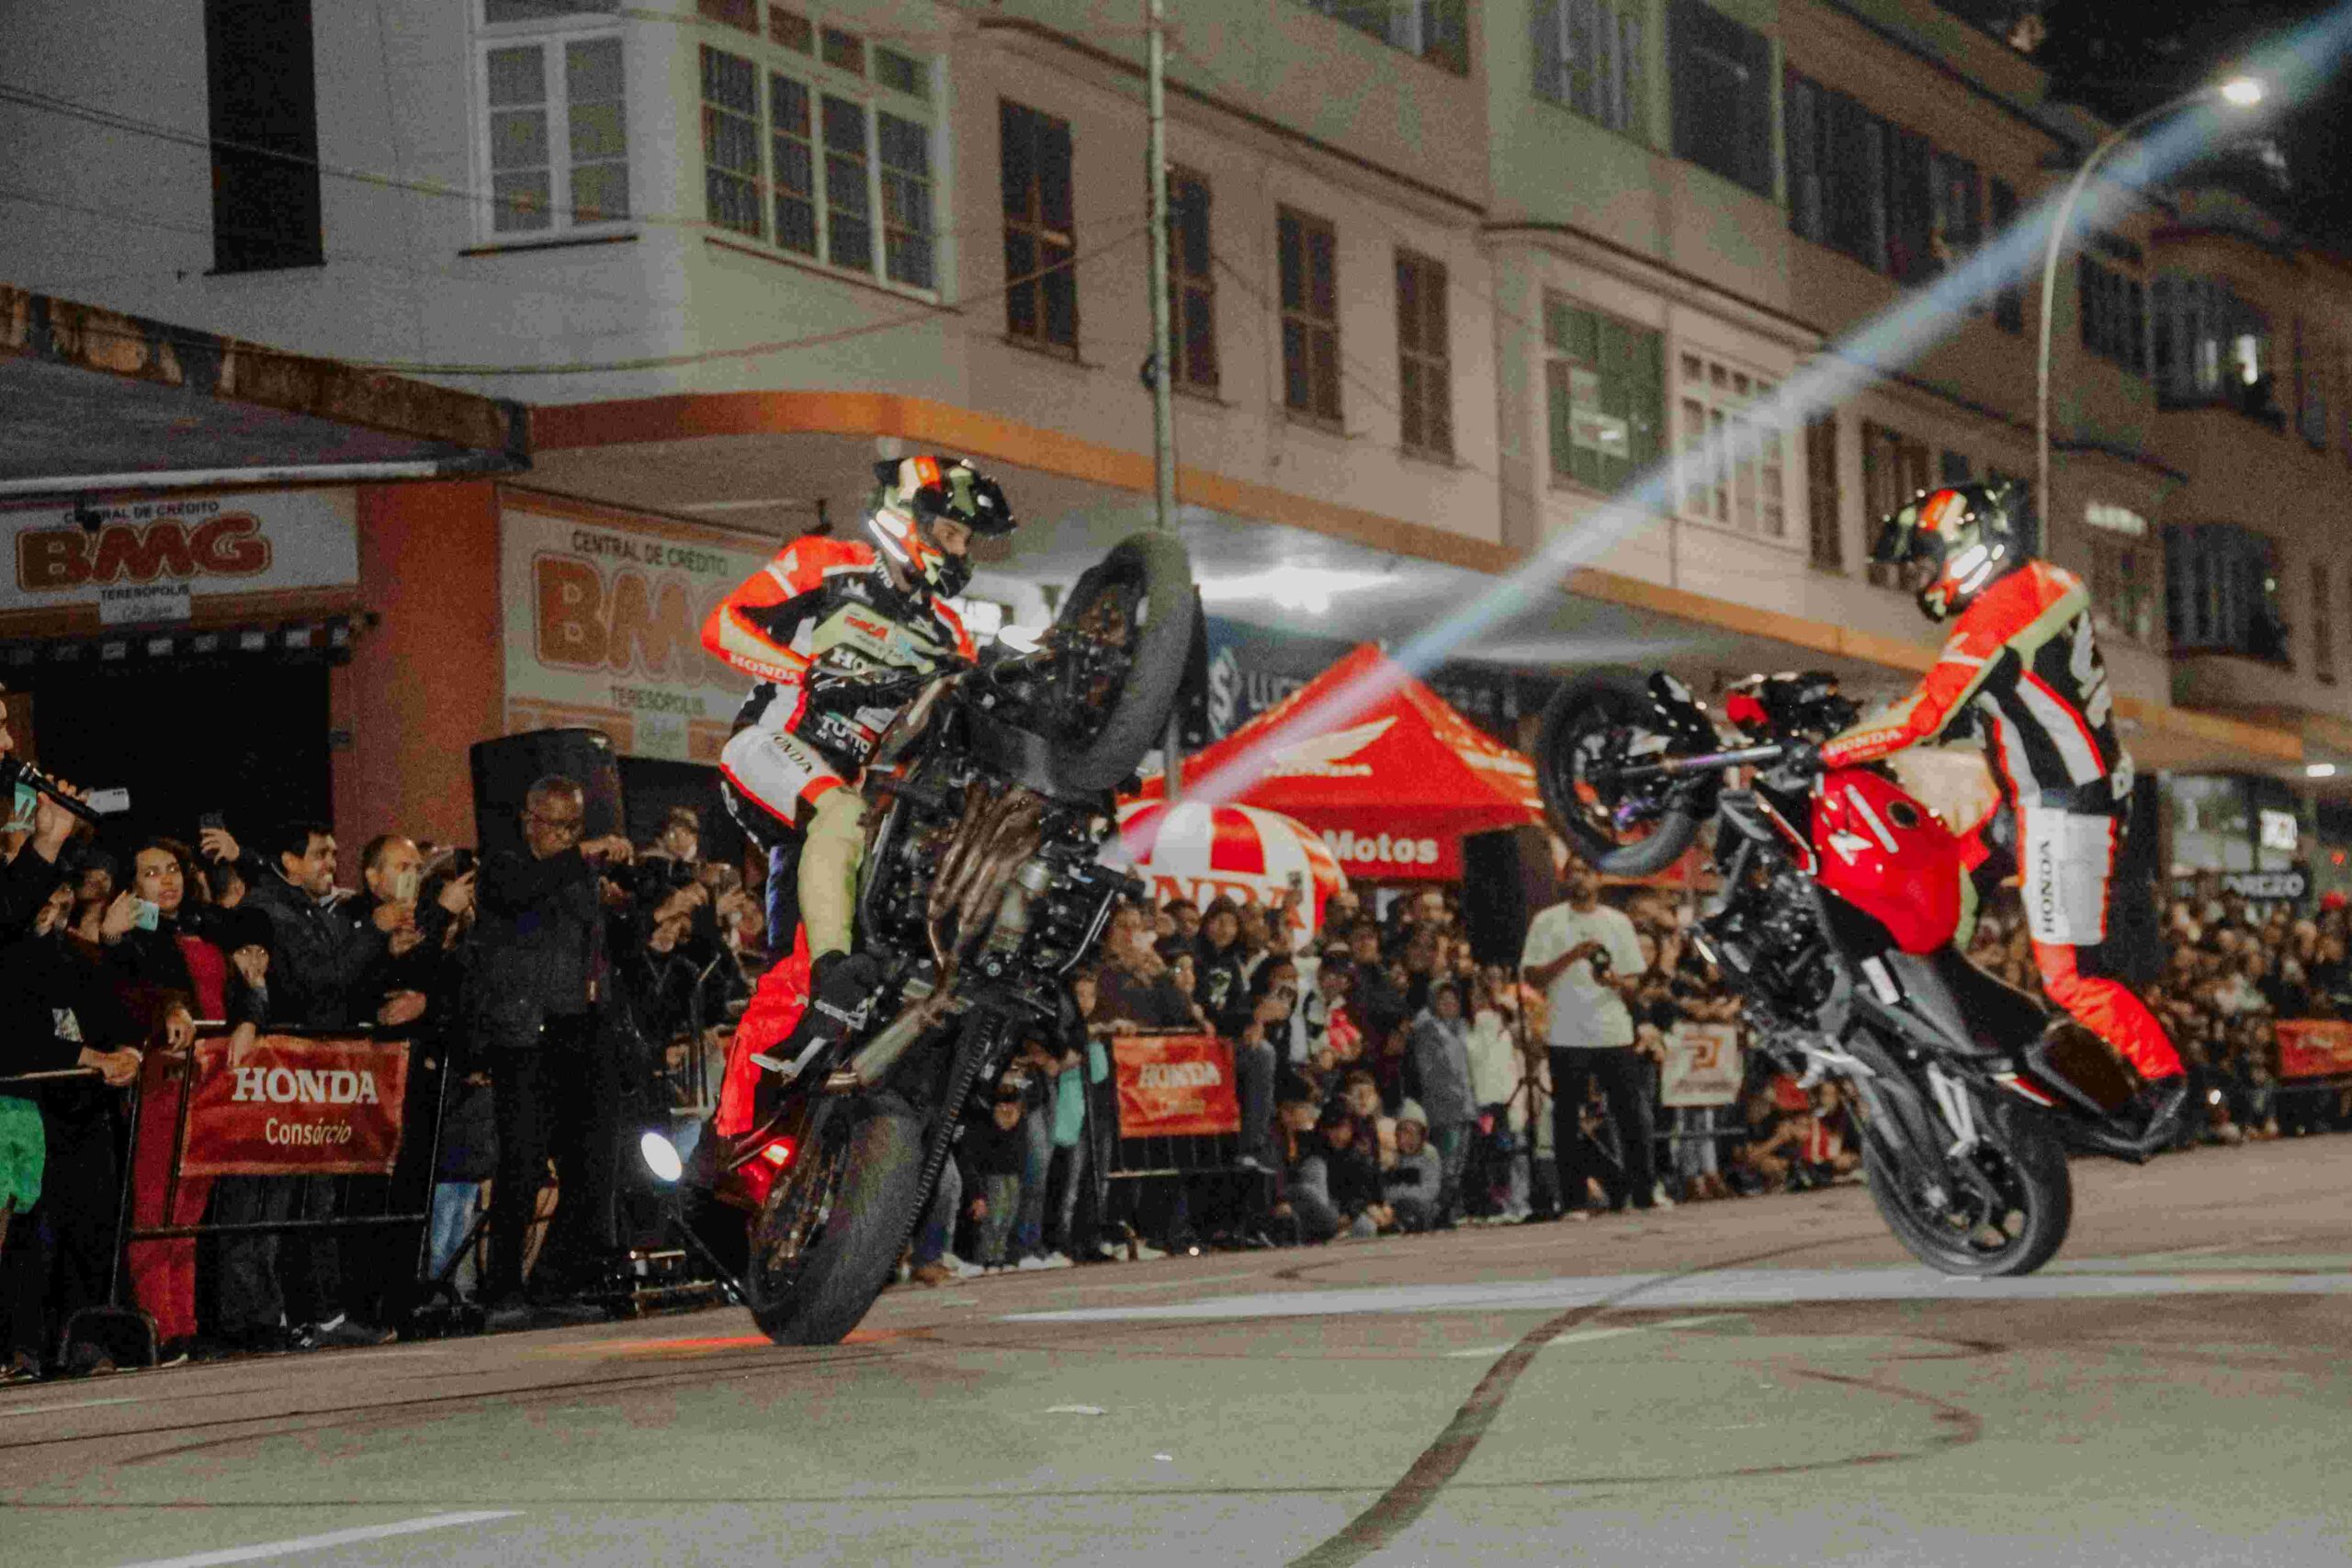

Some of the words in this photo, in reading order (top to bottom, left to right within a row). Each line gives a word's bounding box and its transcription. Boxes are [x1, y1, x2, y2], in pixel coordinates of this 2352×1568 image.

[16, 512, 271, 592] BMG
[571, 529, 642, 562] CENTRAL
[645, 543, 662, 566] DE
[533, 550, 726, 689] BM
[730, 651, 799, 684] HONDA
[1826, 729, 1904, 756] HONDA
[1323, 829, 1440, 864] Motos
[2041, 840, 2054, 933] HONDA
[232, 1066, 379, 1104] HONDA
[1137, 1060, 1222, 1089] HONDA
[266, 1117, 352, 1145] Consórcio
